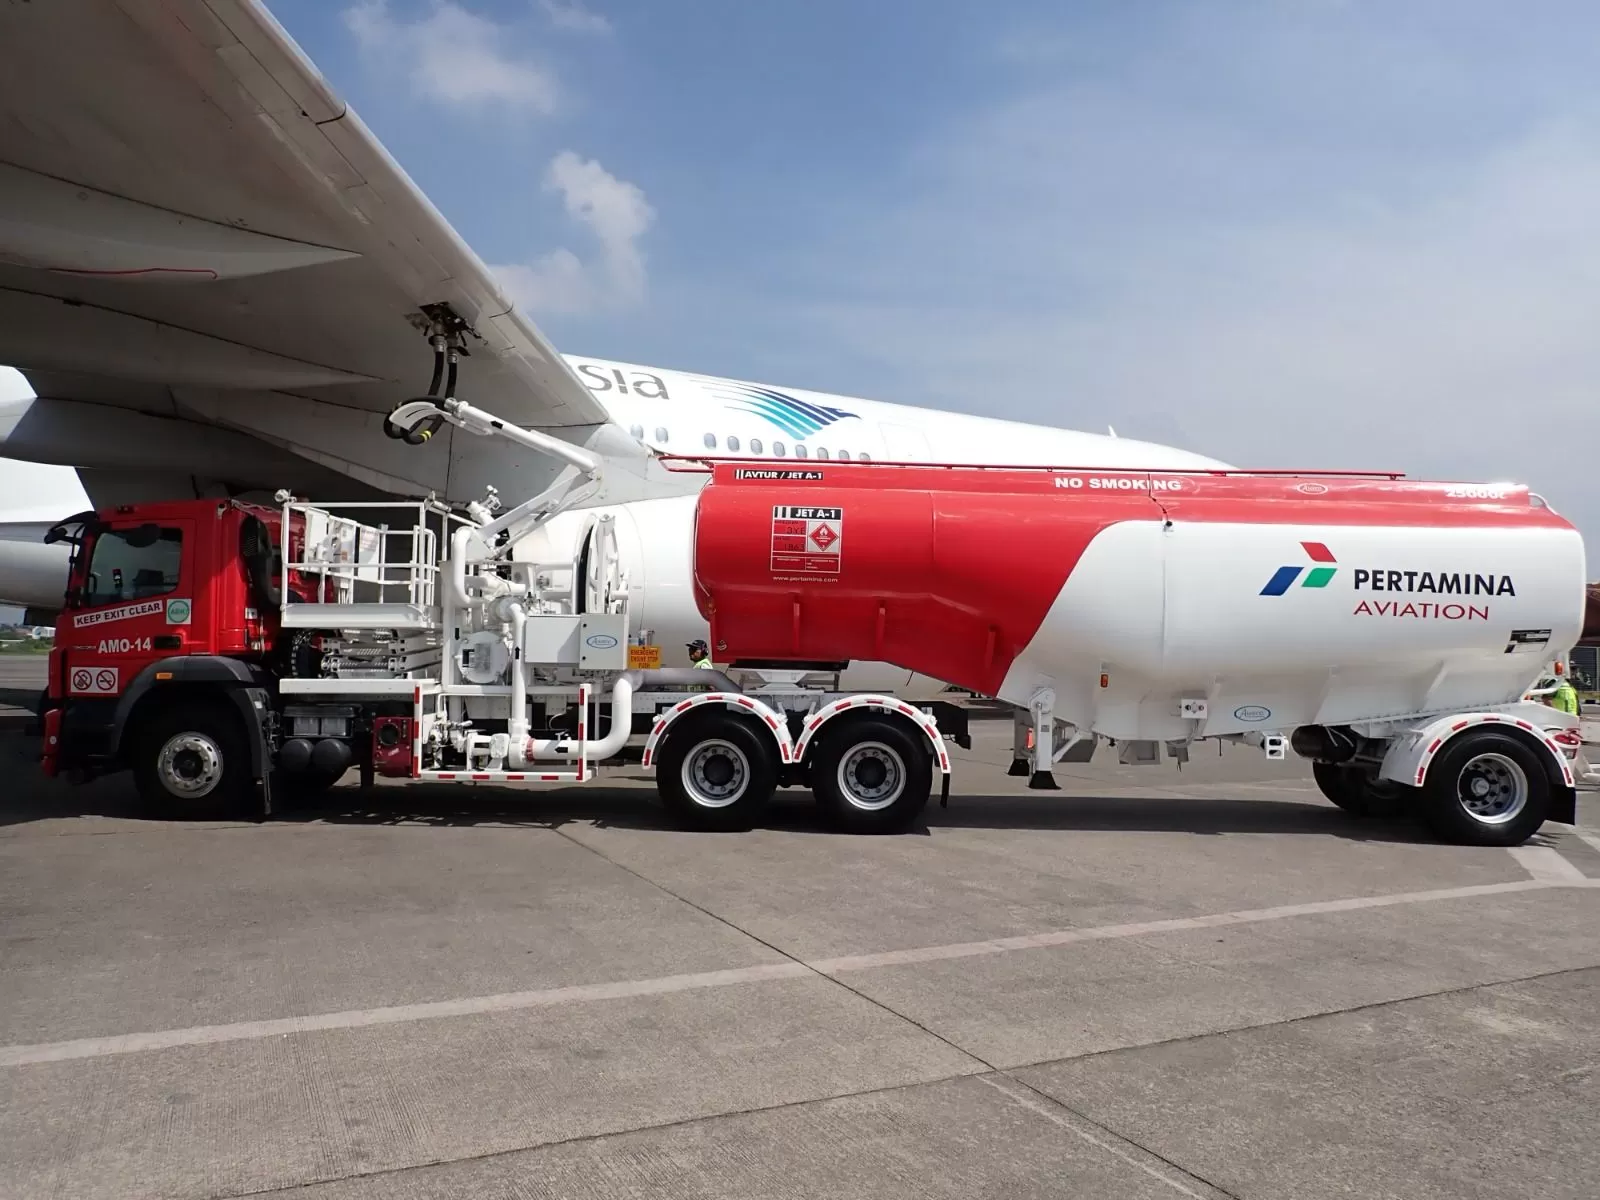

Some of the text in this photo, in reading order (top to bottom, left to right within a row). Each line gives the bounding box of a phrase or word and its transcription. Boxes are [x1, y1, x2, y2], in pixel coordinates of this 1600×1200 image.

[744, 471, 777, 479] AVTUR
[805, 472, 822, 480] A-1
[1054, 477, 1182, 491] NO SMOKING
[795, 508, 836, 518] JET A-1
[1353, 568, 1516, 597] PERTAMINA
[76, 614, 101, 626] KEEP
[104, 608, 126, 620] EXIT
[129, 602, 161, 615] CLEAR
[1353, 600, 1489, 620] AVIATION
[98, 637, 152, 654] AMO-14
